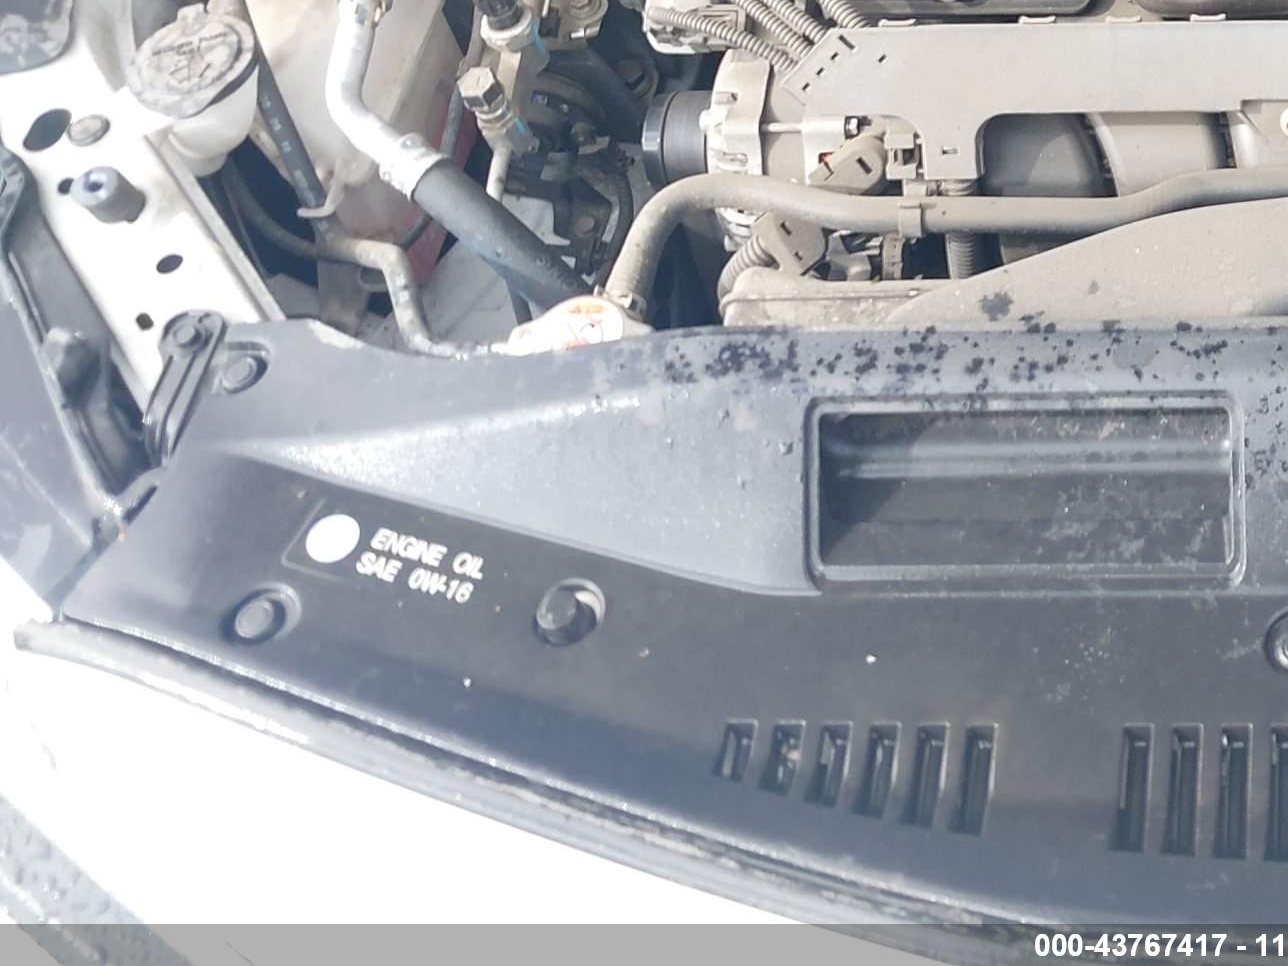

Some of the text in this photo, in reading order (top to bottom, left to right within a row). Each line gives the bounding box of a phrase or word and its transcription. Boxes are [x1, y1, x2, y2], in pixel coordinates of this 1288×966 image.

[356, 551, 474, 604] SAE 0W-16
[371, 527, 484, 580] ENGINE OIL
